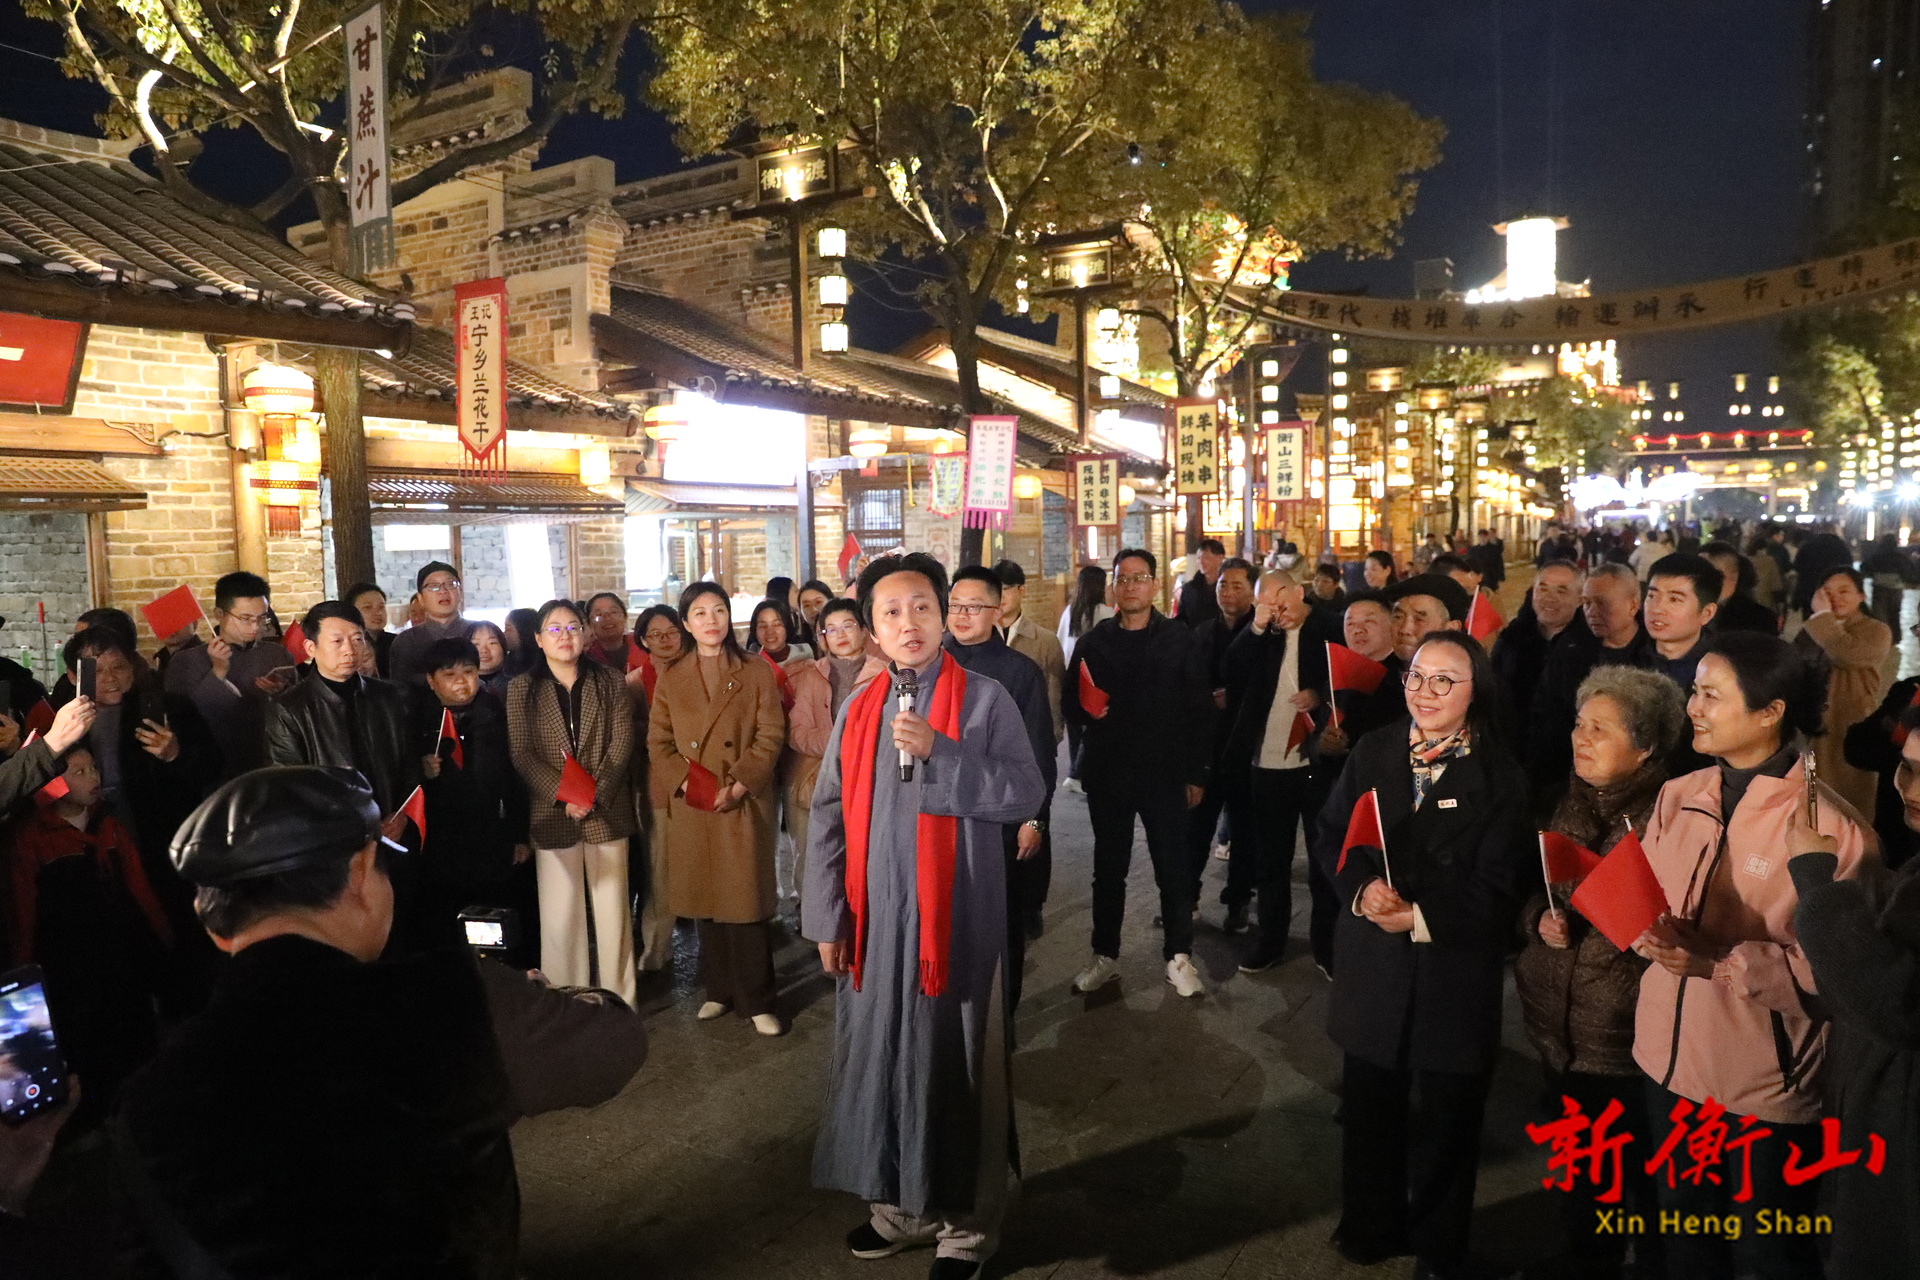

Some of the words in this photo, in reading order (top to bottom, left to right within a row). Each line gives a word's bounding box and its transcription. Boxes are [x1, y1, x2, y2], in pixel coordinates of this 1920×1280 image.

[352, 24, 381, 211] 甘蔗汁
[469, 303, 492, 321] 王记
[471, 323, 490, 443] 宁乡兰花干
[1181, 414, 1195, 485] 鲜切现烤
[1196, 412, 1213, 485] 羊肉串
[1277, 432, 1293, 497] 衡山三鲜粉
[1083, 464, 1094, 521] 现烤不预制
